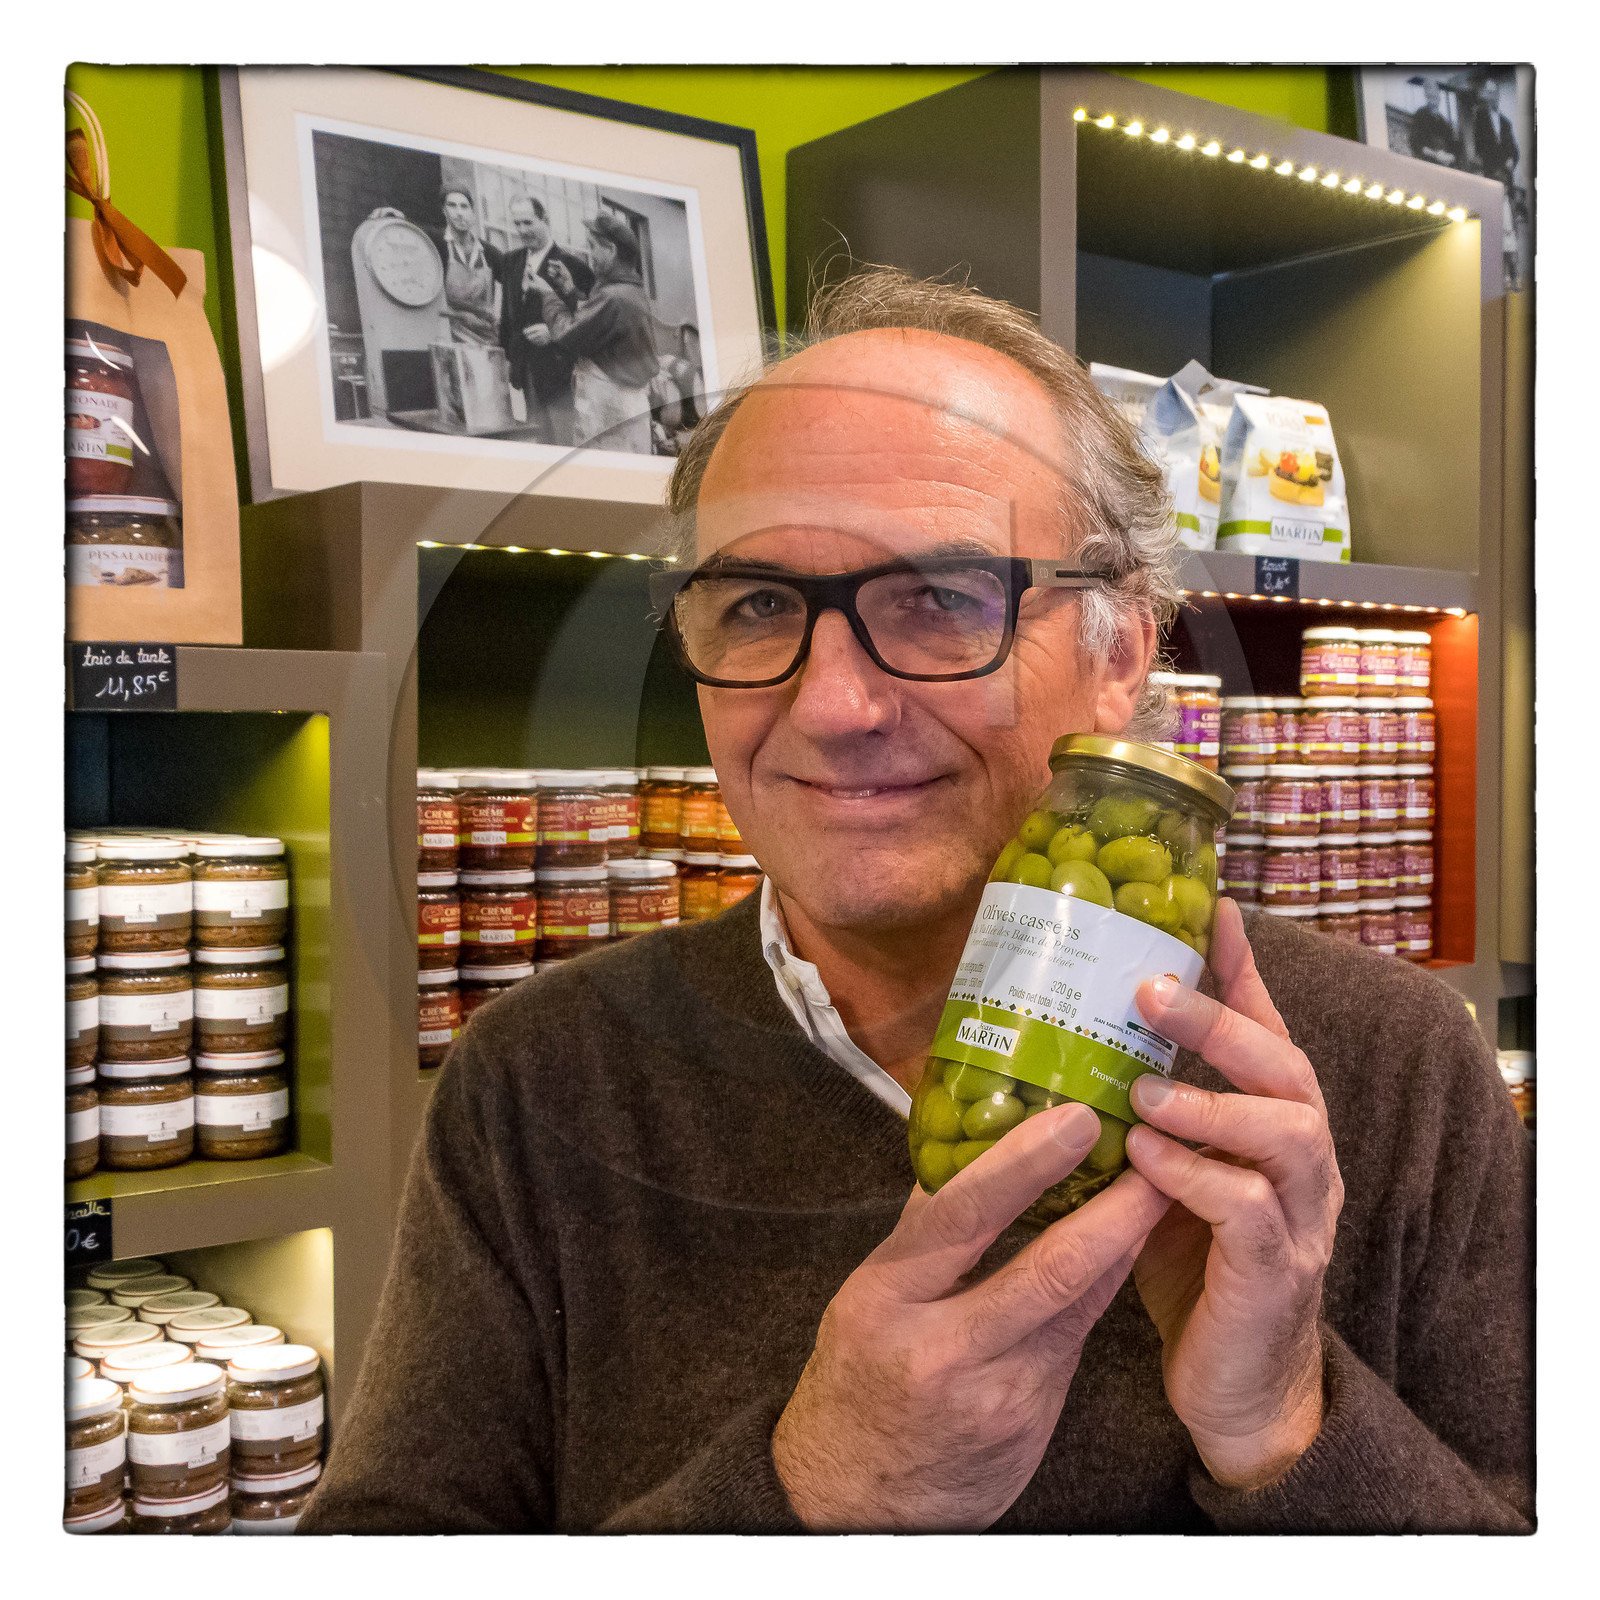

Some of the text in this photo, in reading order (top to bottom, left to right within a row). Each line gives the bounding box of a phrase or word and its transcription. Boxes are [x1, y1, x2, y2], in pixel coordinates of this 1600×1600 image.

[982, 904, 1081, 941] Olives cassées
[999, 940, 1037, 958] d'Origine
[1039, 951, 1075, 969] Protégée
[1011, 928, 1037, 944] Baux
[1053, 939, 1100, 964] Provence
[1007, 985, 1026, 1000] Poids
[1025, 990, 1038, 1002] net
[1038, 993, 1053, 1007] total
[1056, 1000, 1072, 1015] 550
[1071, 1007, 1078, 1019] g
[1050, 980, 1067, 996] 320
[1066, 988, 1073, 1000] g
[1089, 1065, 1130, 1091] Provençal
